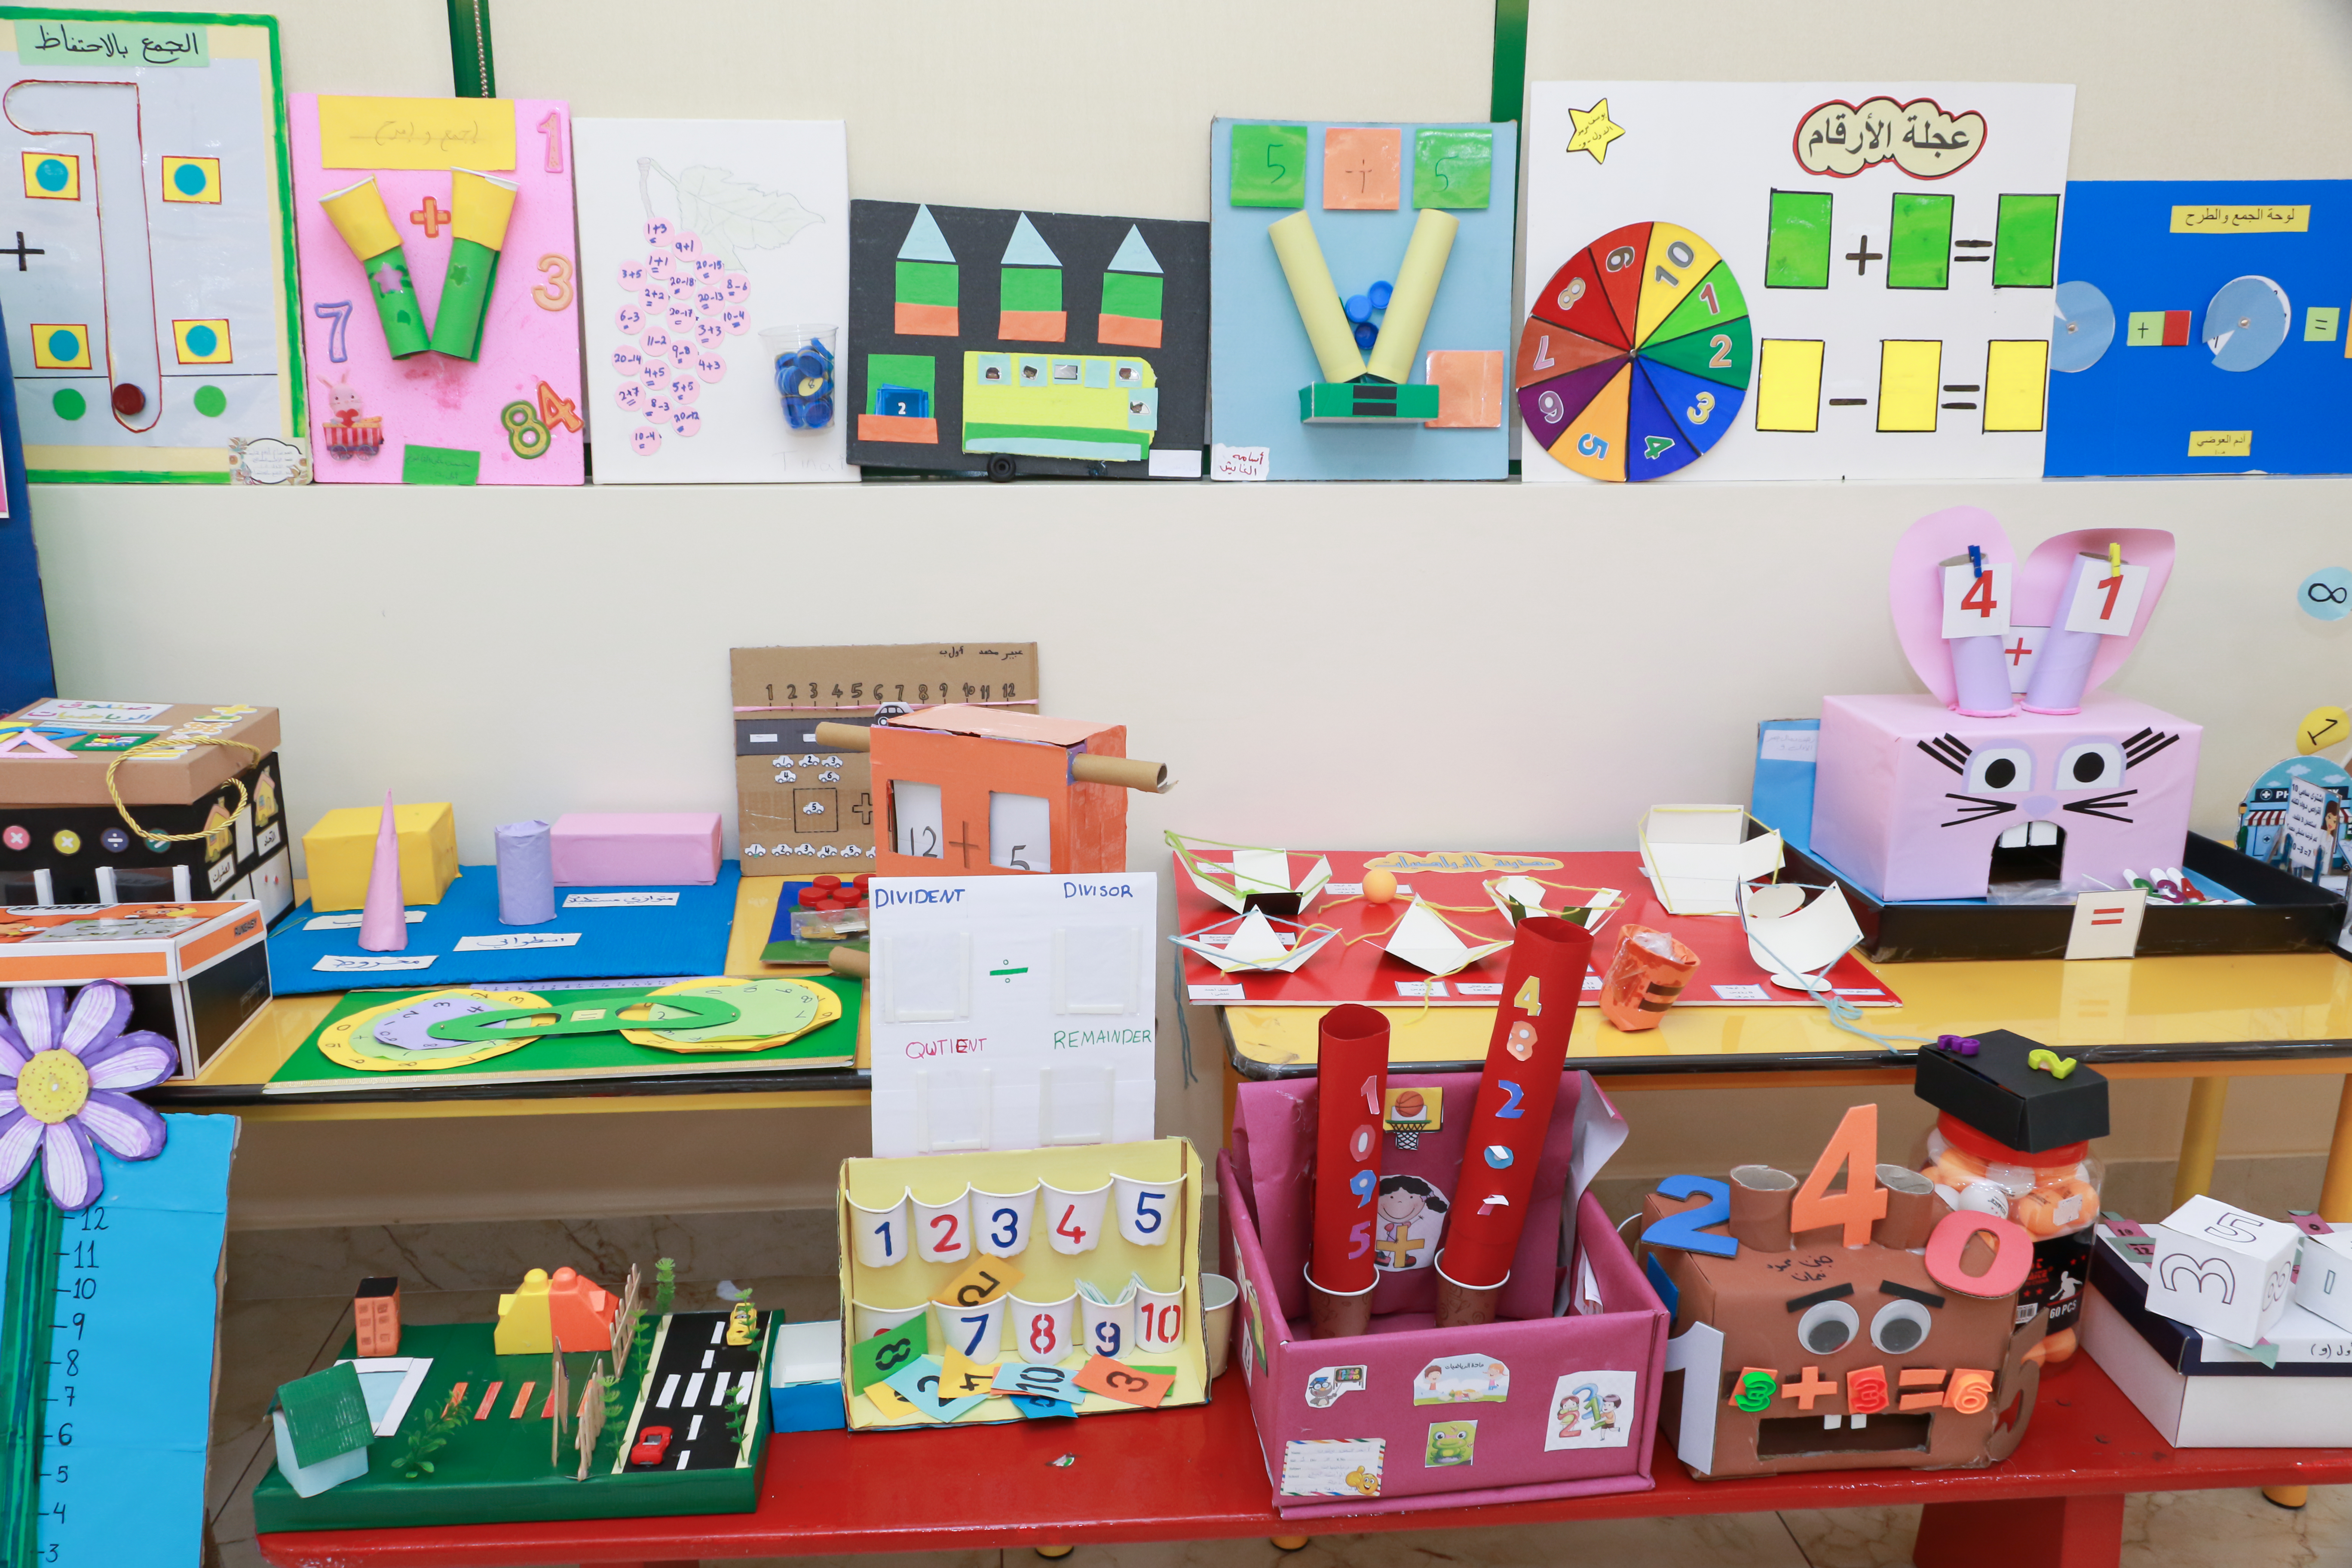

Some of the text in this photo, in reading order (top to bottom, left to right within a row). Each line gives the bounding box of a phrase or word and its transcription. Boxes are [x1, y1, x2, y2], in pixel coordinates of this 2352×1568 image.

[35, 24, 199, 64] الجمع بالاحتفاظ
[1808, 112, 1970, 158] عجلة الأرقام
[1267, 144, 1459, 193] 5 5
[2185, 208, 2295, 226] لوحة الجمع والطرح
[1655, 241, 1695, 288] 10
[532, 253, 573, 311] 3
[1557, 277, 1586, 310] 8
[1699, 282, 1720, 315] 1
[314, 300, 353, 363] 7
[1533, 335, 1555, 371] 7
[1709, 334, 1733, 368] 2
[536, 380, 585, 433] 4
[898, 401, 906, 415] 2
[1687, 391, 1715, 425] 3
[501, 399, 551, 460] 8
[1577, 432, 1609, 460] 5
[2197, 435, 2231, 447] العوضي
[1644, 435, 1675, 460] 4
[1960, 570, 2124, 620] 4 1
[766, 682, 1016, 701] 1 2 3 4 5 6 7 8 9 10 11 12
[2306, 718, 2338, 746] 1
[755, 845, 757, 854] 1
[910, 826, 938, 858] 12
[1375, 855, 1556, 870] مدينة الرياضيات
[874, 881, 1133, 909] DIVIDENT DIVISOR
[1514, 975, 1542, 1017] 4
[1054, 1029, 1152, 1050] REMAINDER
[1507, 1020, 1538, 1062] 8
[1361, 1075, 1380, 1115] 1
[1495, 1079, 1525, 1118] 2
[1350, 1169, 1377, 1209] 9
[1790, 1103, 1888, 1247] 4
[81, 1207, 109, 1231] 12
[874, 1191, 1166, 1257] 1 2 3 4 5
[1641, 1174, 1739, 1259] 2
[2204, 1212, 2263, 1243] 5
[74, 1240, 99, 1268] 11
[1348, 1221, 1371, 1260] 5
[1925, 1209, 2034, 1299] 0
[73, 1277, 97, 1299] 10
[957, 1271, 1001, 1306] 5
[2160, 1253, 2236, 1305] 3
[73, 1313, 85, 1341] 9
[961, 1302, 1181, 1357] 7 8 9 10
[67, 1349, 79, 1377] 8
[875, 1338, 911, 1371] 8
[64, 1386, 75, 1407] 7
[1015, 1367, 1066, 1393] 10
[1106, 1371, 1149, 1392] 3
[1734, 1370, 1777, 1412] 3
[1951, 1372, 1994, 1414] 6
[1664, 1320, 1725, 1475] 1
[58, 1423, 73, 1446] 6
[56, 1465, 69, 1483] 5
[53, 1501, 66, 1524] 4
[46, 1544, 59, 1563] 3
